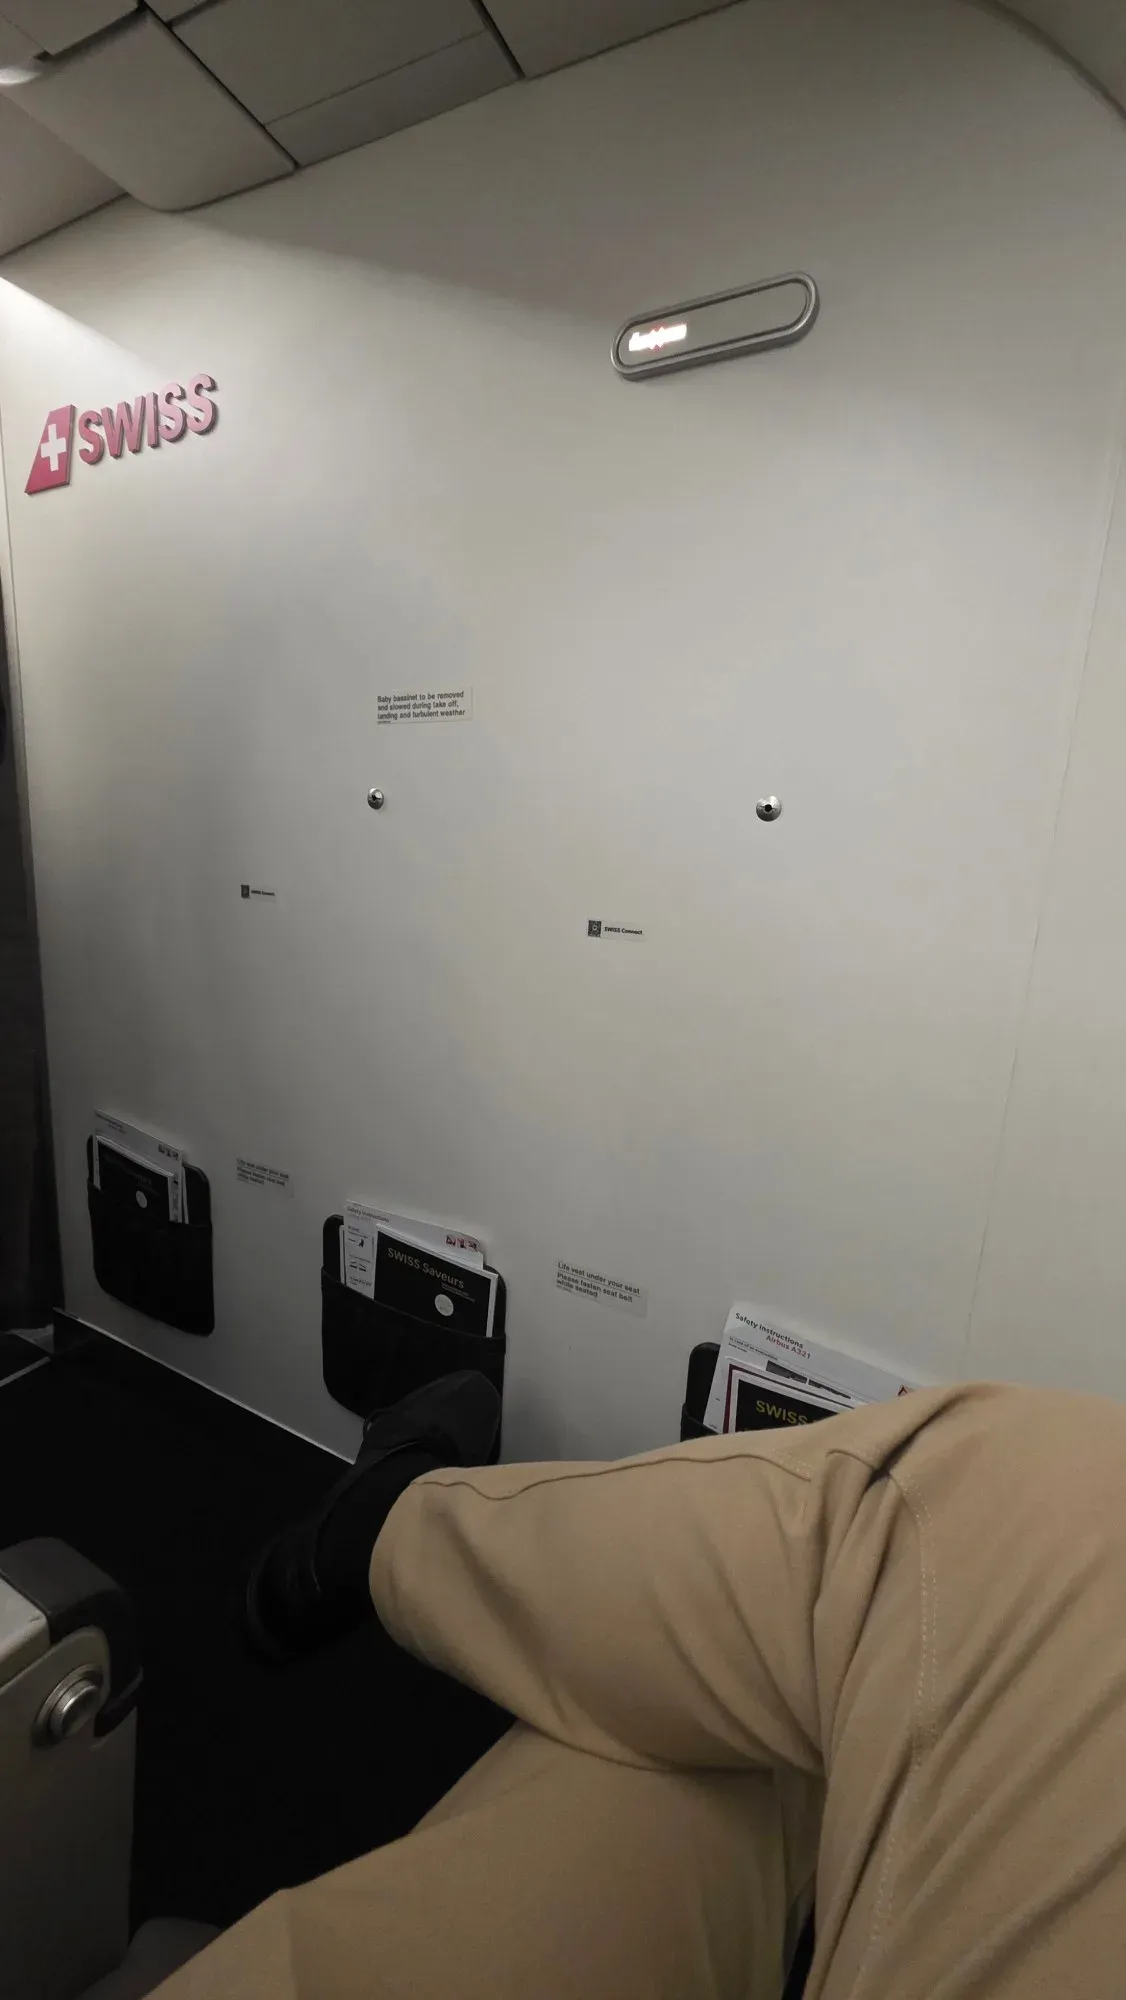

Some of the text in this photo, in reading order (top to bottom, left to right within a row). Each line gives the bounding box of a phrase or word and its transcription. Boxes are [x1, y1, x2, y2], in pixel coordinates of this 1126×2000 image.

[78, 373, 217, 465] SWISS
[393, 694, 418, 702] bassinet
[437, 691, 464, 699] removed
[412, 702, 432, 710] during
[377, 712, 398, 720] landing
[412, 710, 439, 718] turbulent
[388, 1247, 420, 1269] SWISS
[422, 1262, 464, 1288] Saveurs
[557, 1262, 570, 1271] Life
[586, 1272, 606, 1282] under
[607, 1279, 623, 1289] your
[624, 1284, 641, 1294] seat
[556, 1279, 574, 1289] while
[556, 1271, 579, 1284] Please
[580, 1279, 602, 1292] fasten
[603, 1288, 617, 1298] seat
[735, 1313, 758, 1328] Safety
[759, 1324, 803, 1348] instructions
[766, 1335, 790, 1350] Airbus
[790, 1346, 811, 1360] A321
[756, 1400, 808, 1425] SWISS
